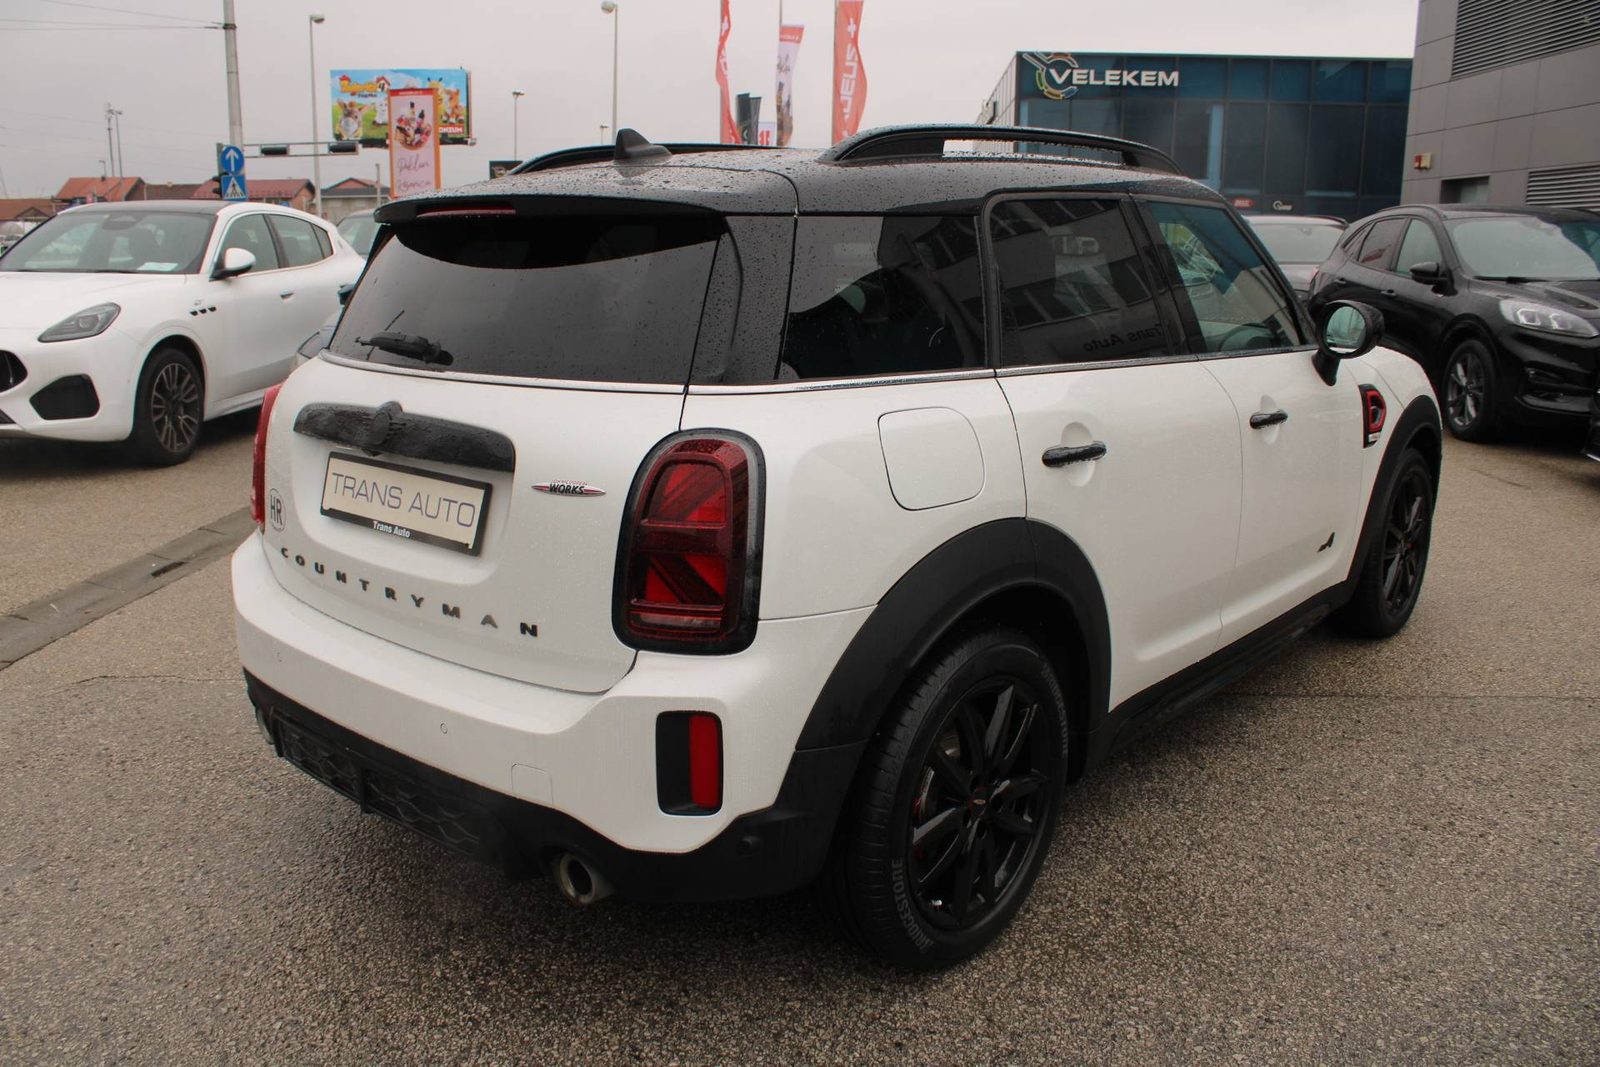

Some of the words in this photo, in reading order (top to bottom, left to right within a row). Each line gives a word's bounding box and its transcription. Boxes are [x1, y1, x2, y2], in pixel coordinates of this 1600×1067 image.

[1049, 68, 1179, 87] VELEKEM
[332, 472, 403, 510] TRANS
[408, 491, 476, 528] AUTO
[549, 483, 585, 495] WORKS
[270, 494, 283, 526] HR
[373, 520, 393, 534] Trans
[393, 525, 411, 539] Auto
[281, 547, 538, 638] COUNTRYMAN
